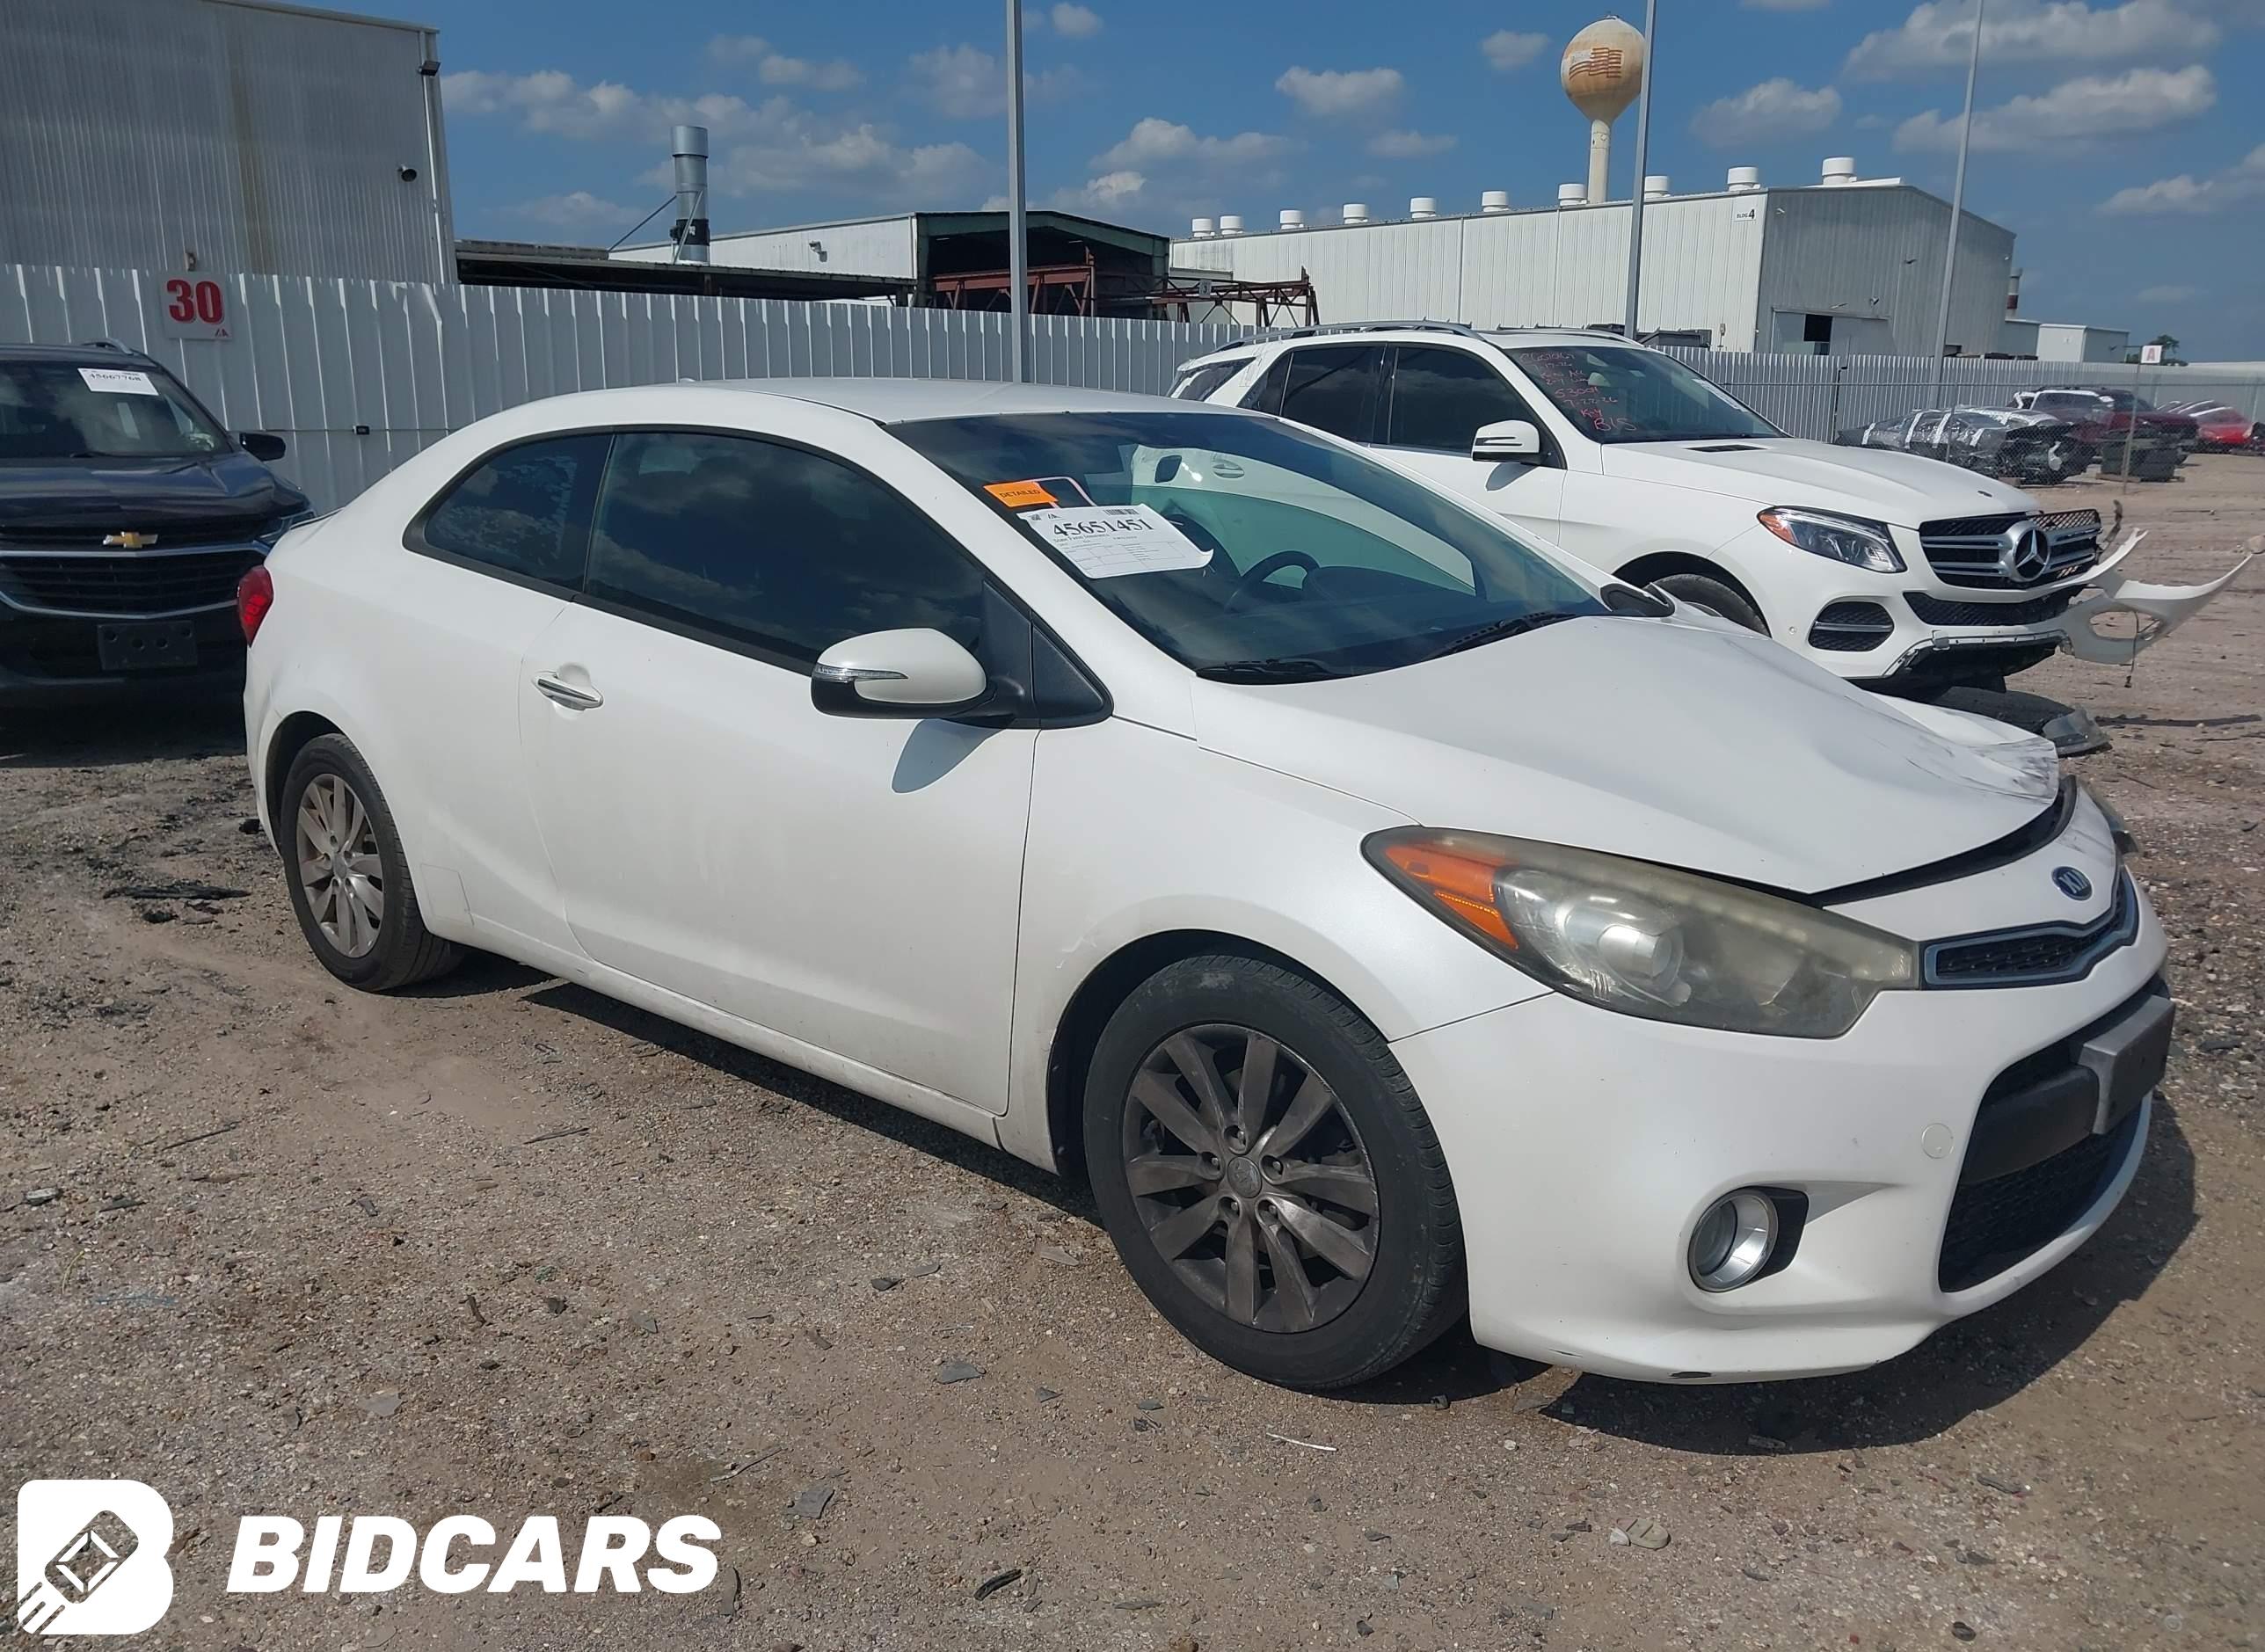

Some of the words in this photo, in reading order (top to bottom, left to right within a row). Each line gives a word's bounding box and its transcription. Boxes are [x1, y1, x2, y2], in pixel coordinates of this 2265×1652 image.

[1749, 208, 1755, 220] 4
[167, 280, 224, 324] 30
[2146, 347, 2156, 361] A
[999, 489, 1041, 499] DETAILED
[1053, 519, 1154, 536] 45651451
